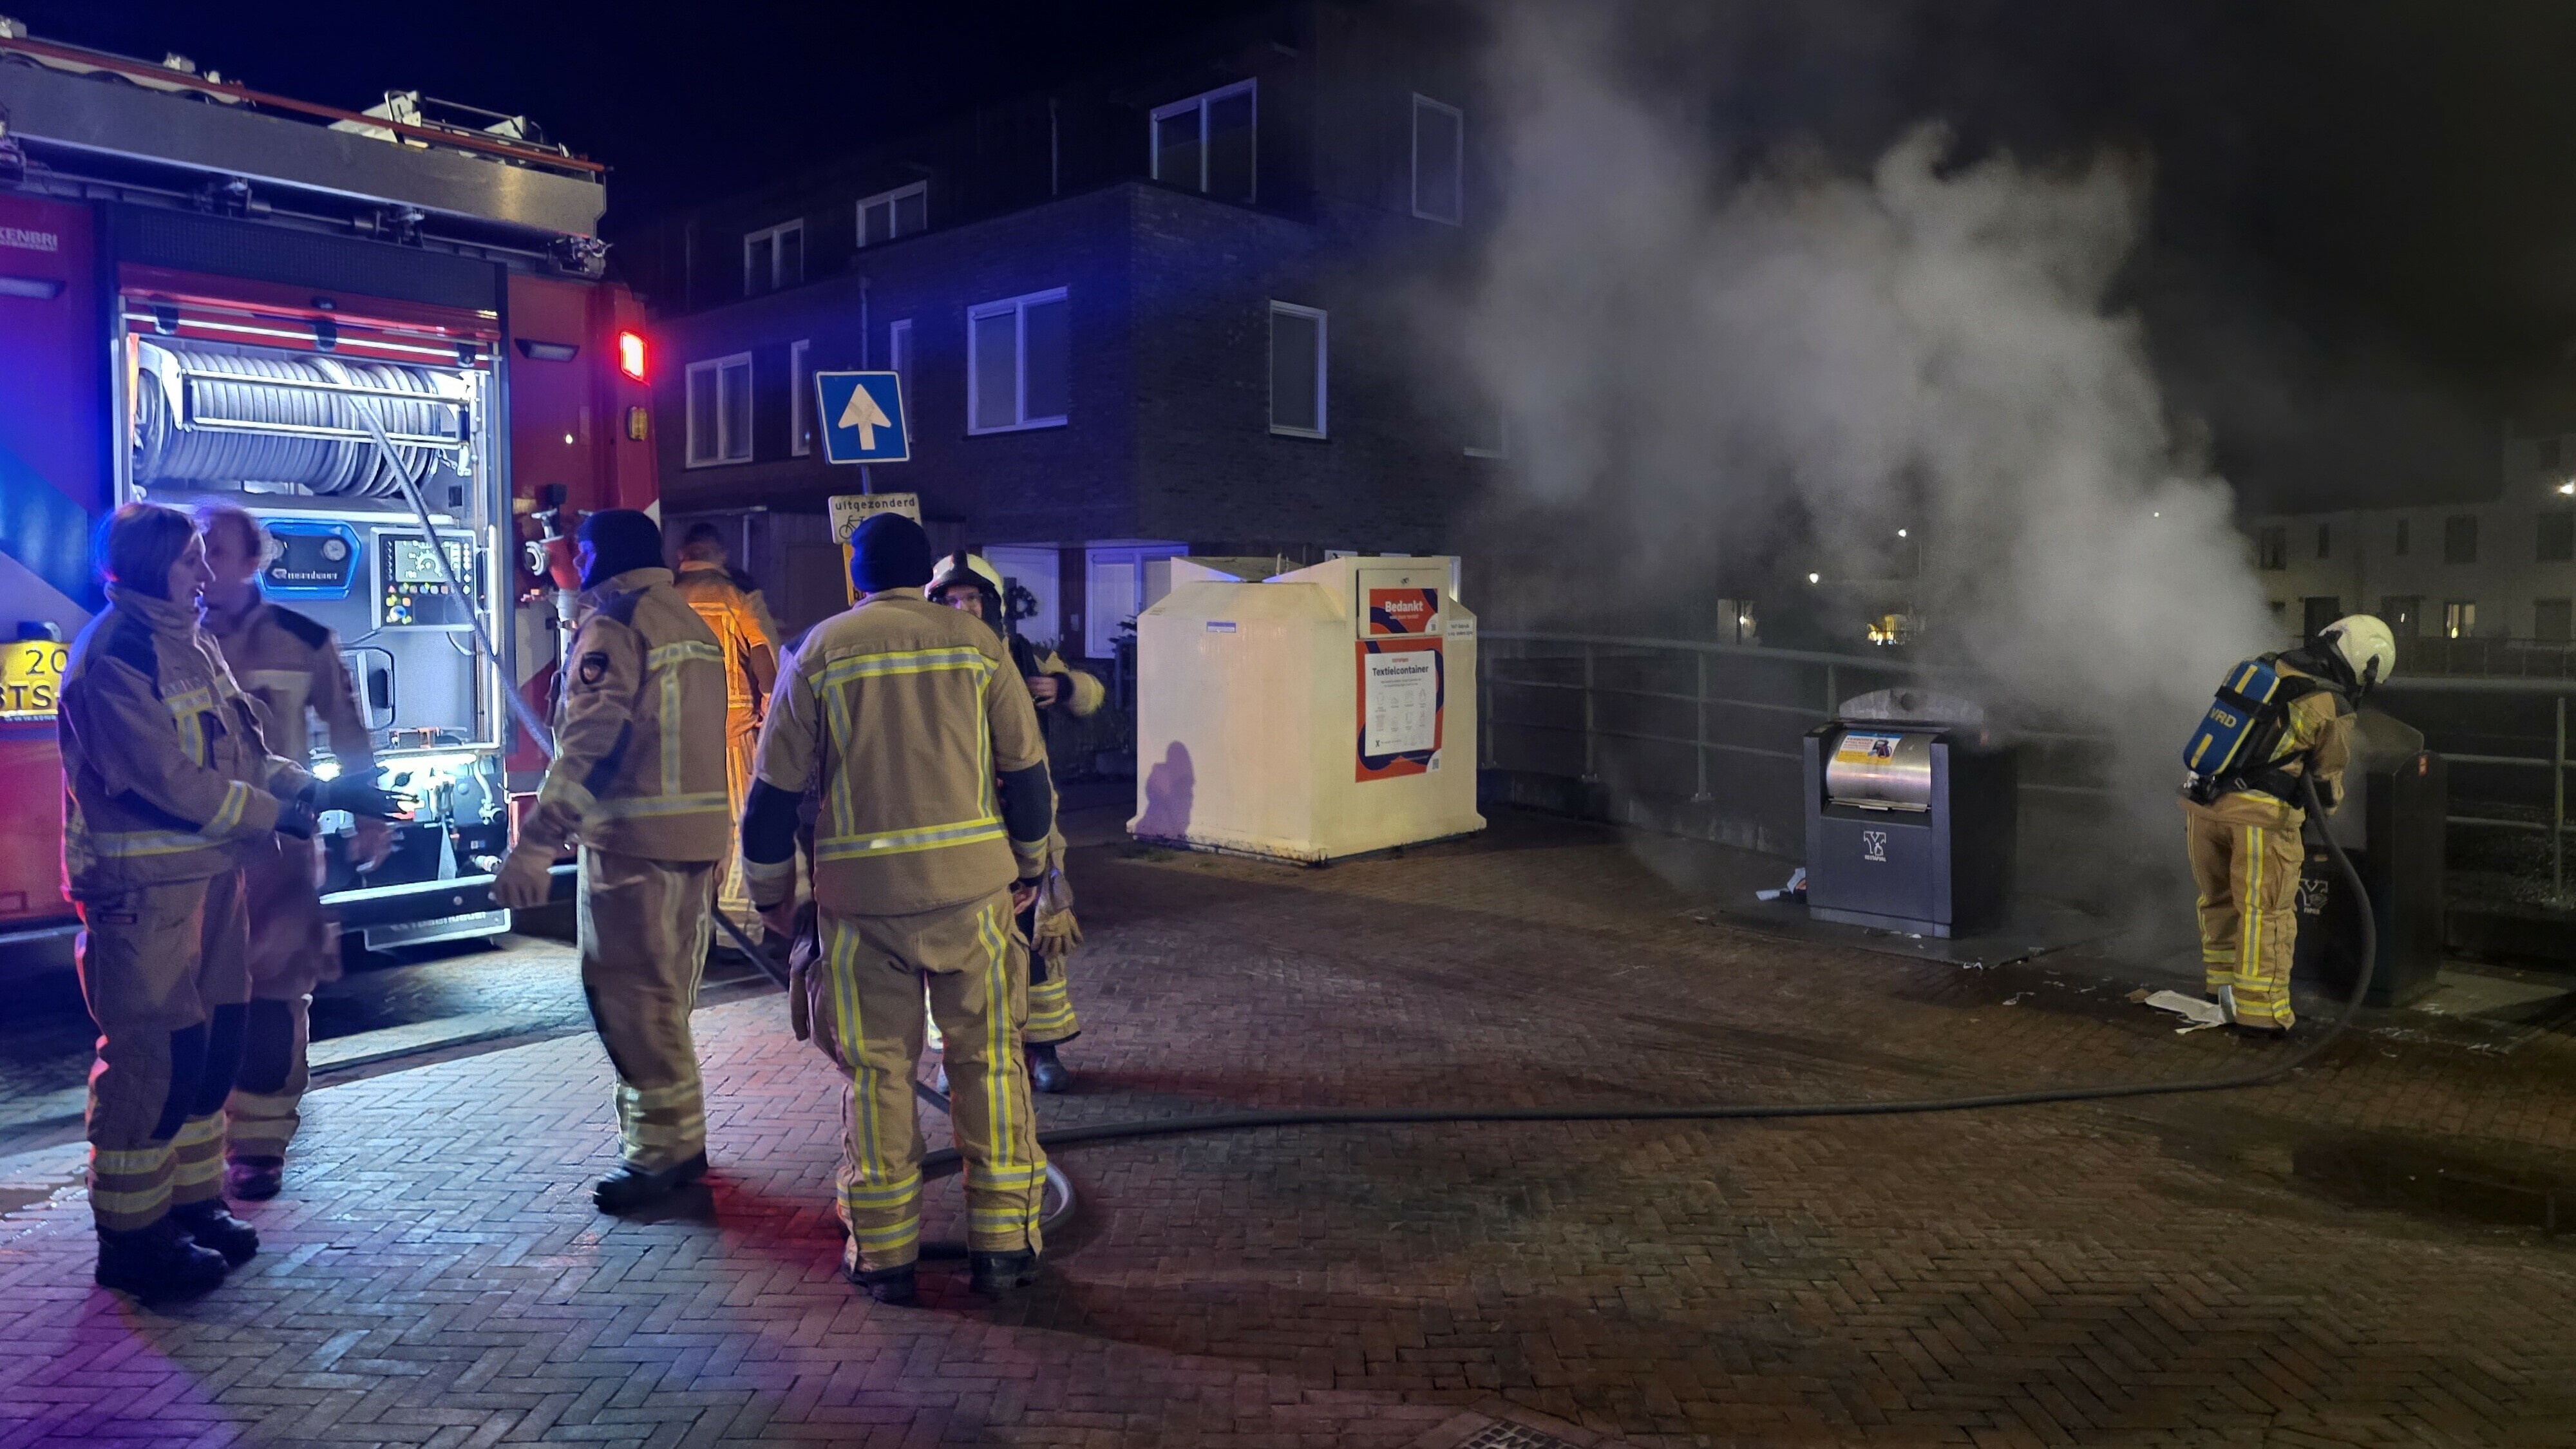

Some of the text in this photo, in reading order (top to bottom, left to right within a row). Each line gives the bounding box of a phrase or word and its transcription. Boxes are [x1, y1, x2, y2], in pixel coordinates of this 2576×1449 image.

[835, 497, 915, 511] uitgezonderd
[1385, 600, 1423, 612] Bedankt
[25, 649, 68, 675] 20
[1372, 665, 1428, 676] Textielcontainer
[2211, 708, 2237, 728] VRD
